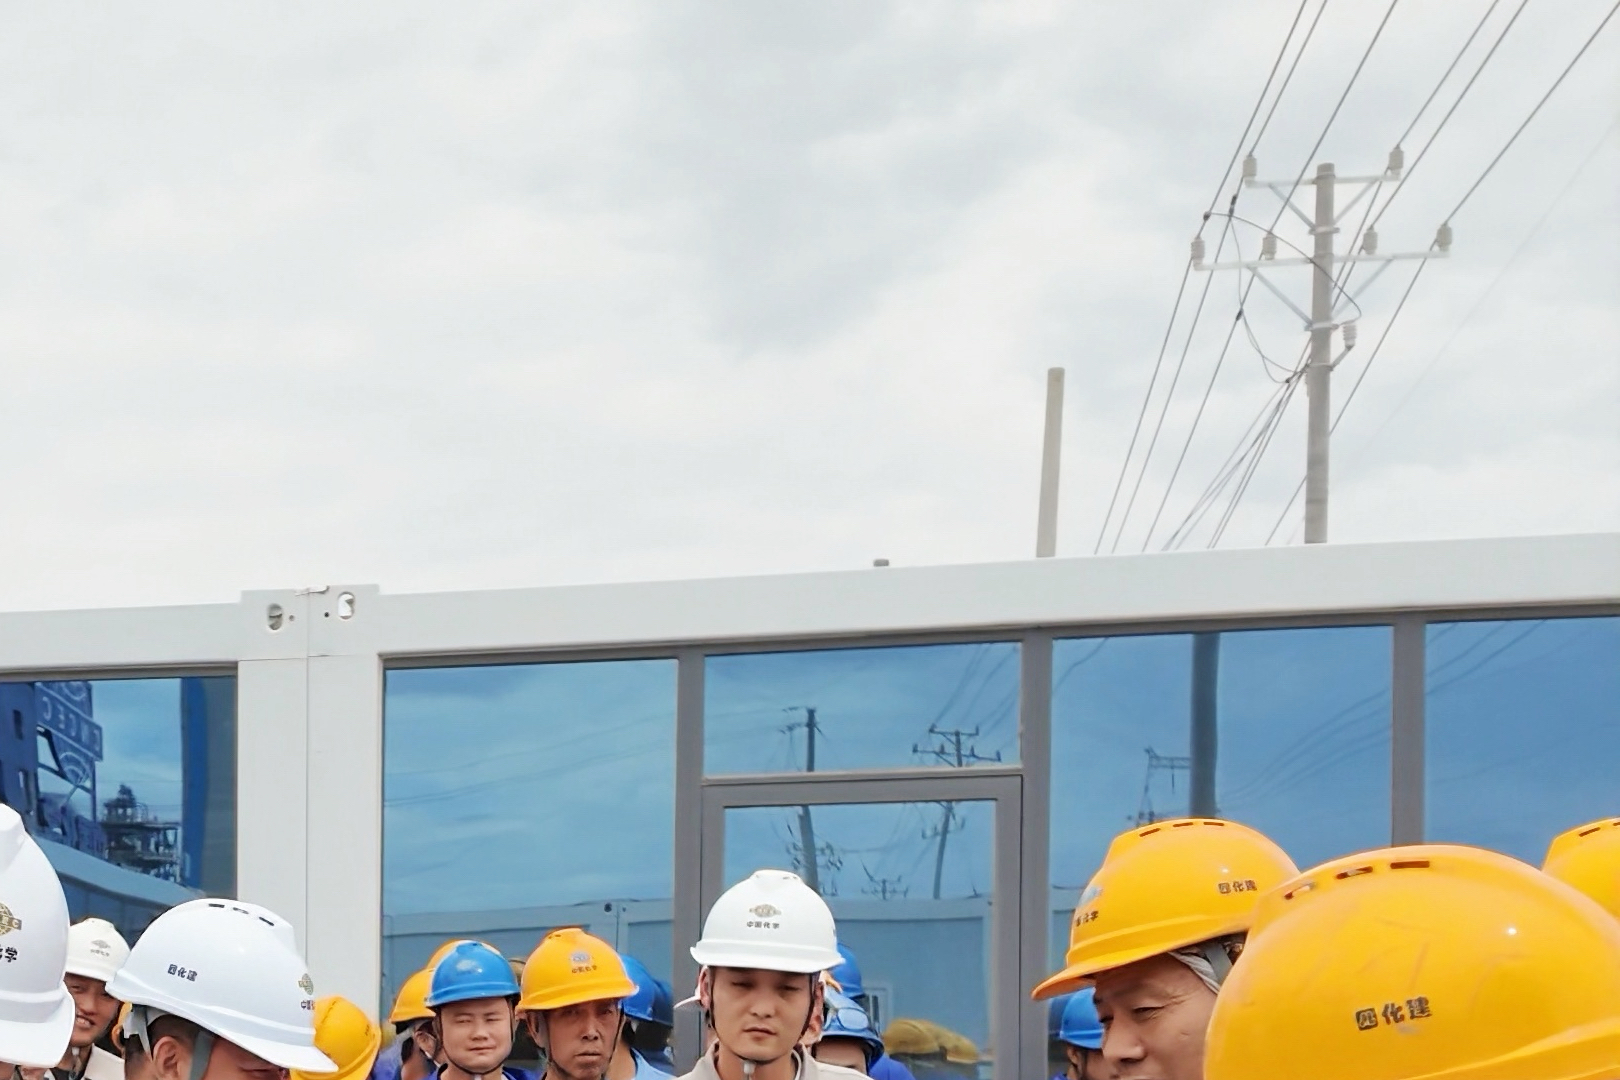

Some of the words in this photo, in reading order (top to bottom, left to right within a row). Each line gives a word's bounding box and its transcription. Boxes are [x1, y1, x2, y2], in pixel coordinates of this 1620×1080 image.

[1218, 880, 1257, 894] 四化建
[168, 963, 198, 982] 四化建
[1356, 996, 1432, 1031] 四化建
